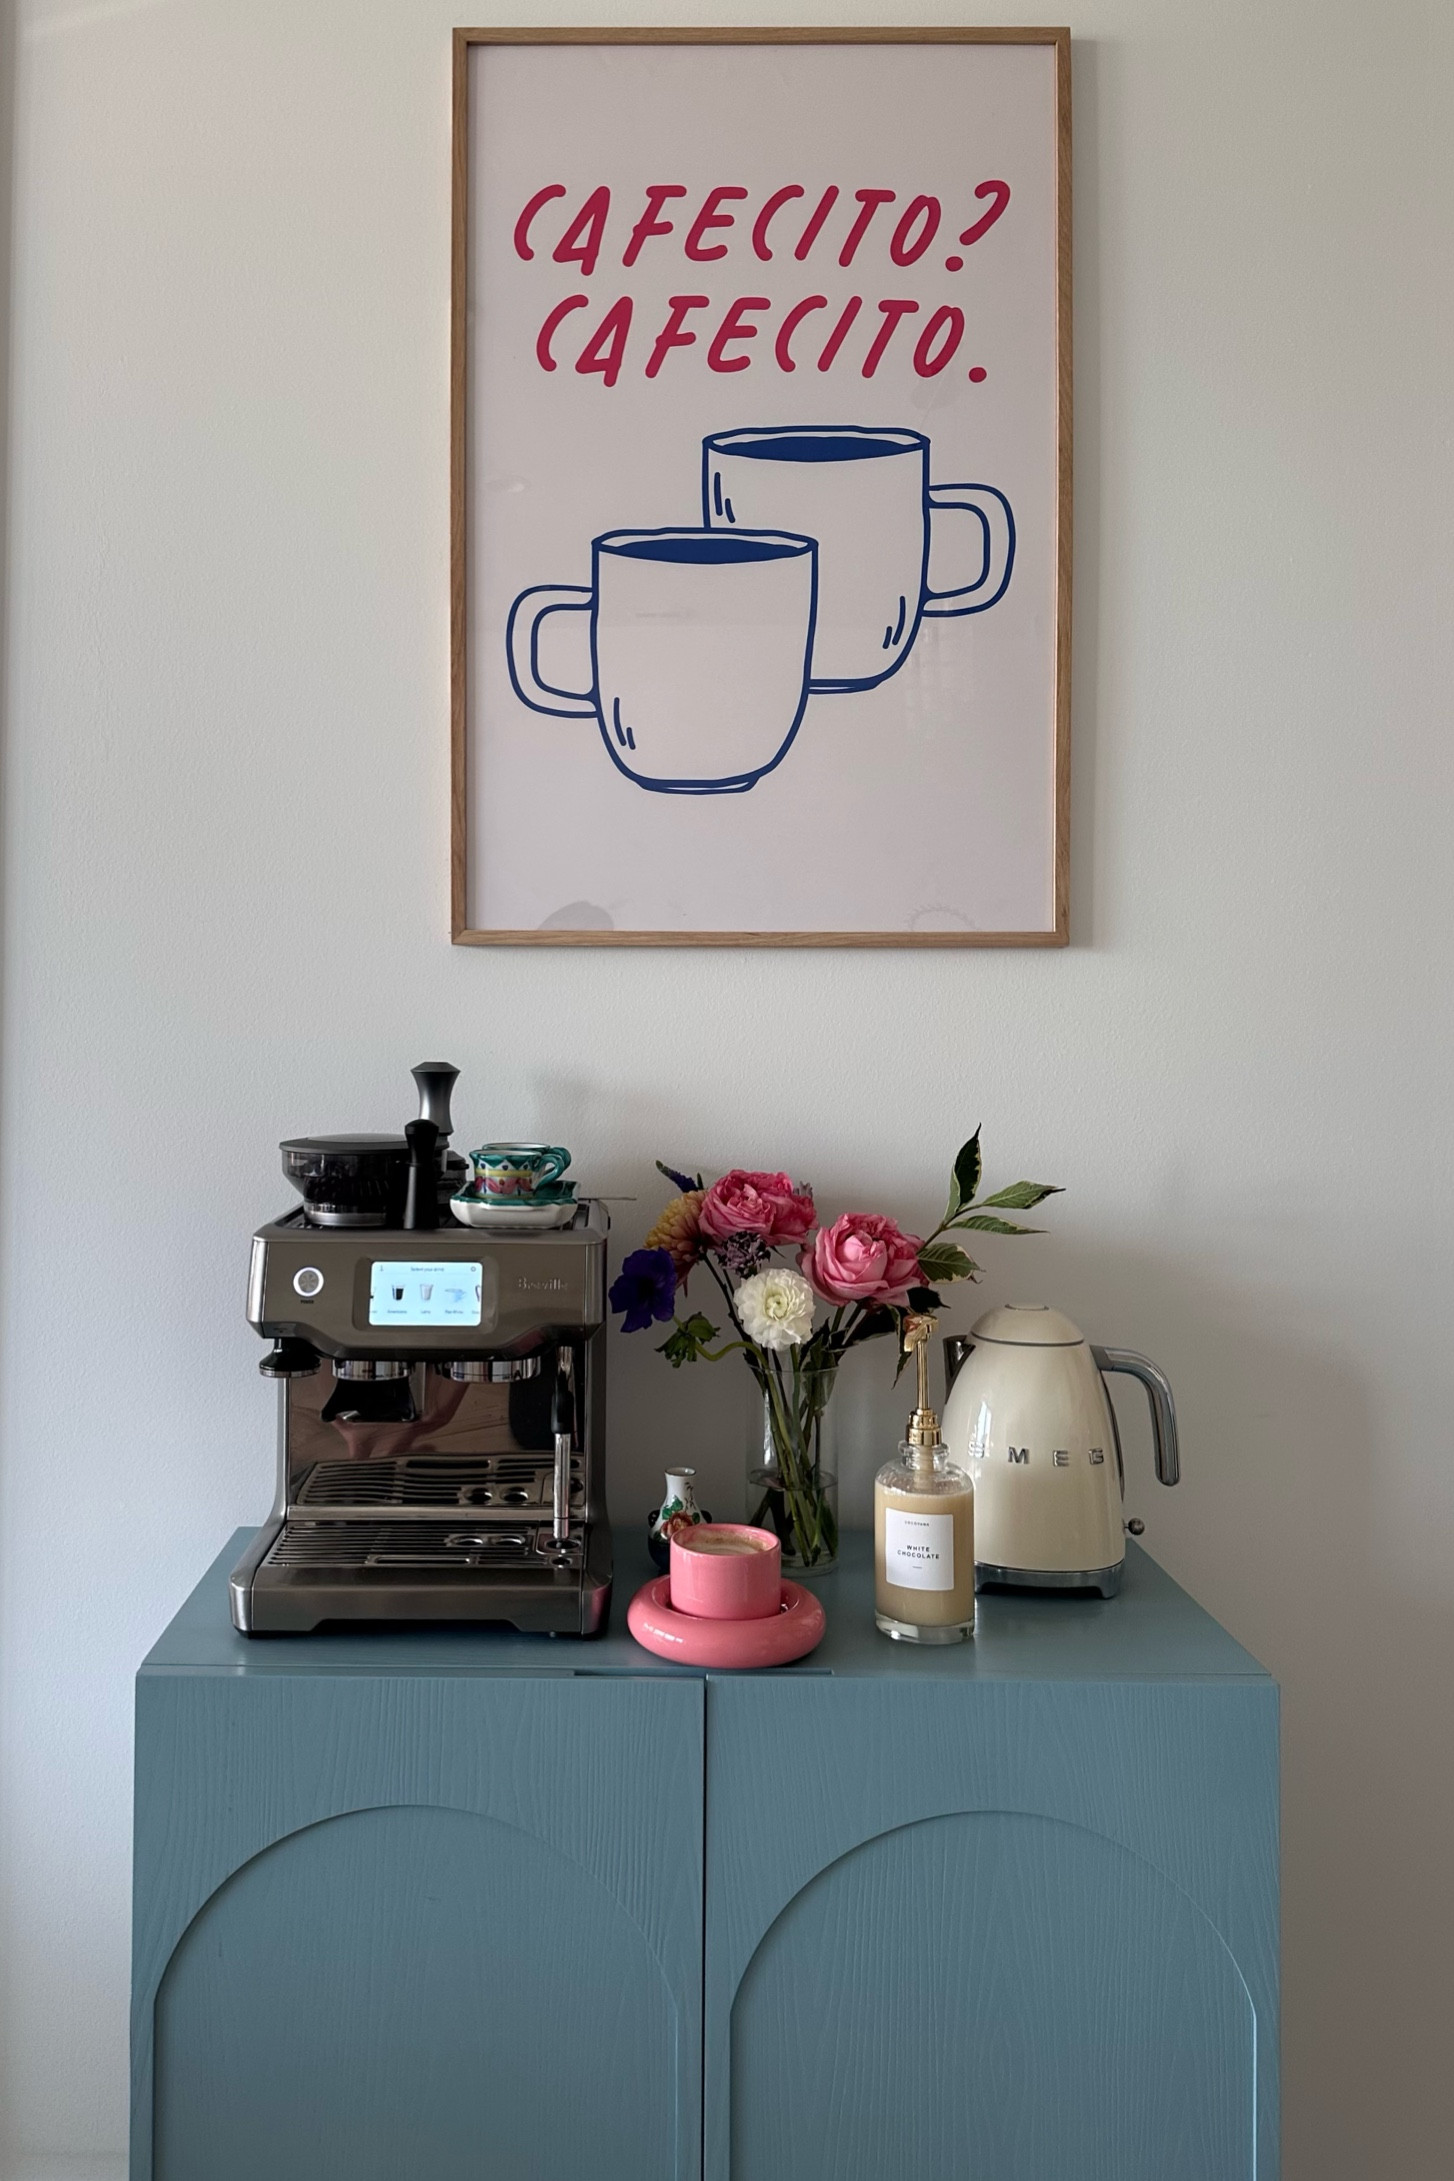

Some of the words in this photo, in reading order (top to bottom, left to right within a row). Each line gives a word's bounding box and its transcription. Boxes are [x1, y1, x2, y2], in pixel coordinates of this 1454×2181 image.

[513, 179, 1010, 276] CAFECITO?
[535, 294, 987, 387] CAFECITO.
[968, 1440, 1105, 1467] SMEG
[897, 1549, 940, 1560] CHOCOLATE
[906, 1545, 930, 1553] WHITE
